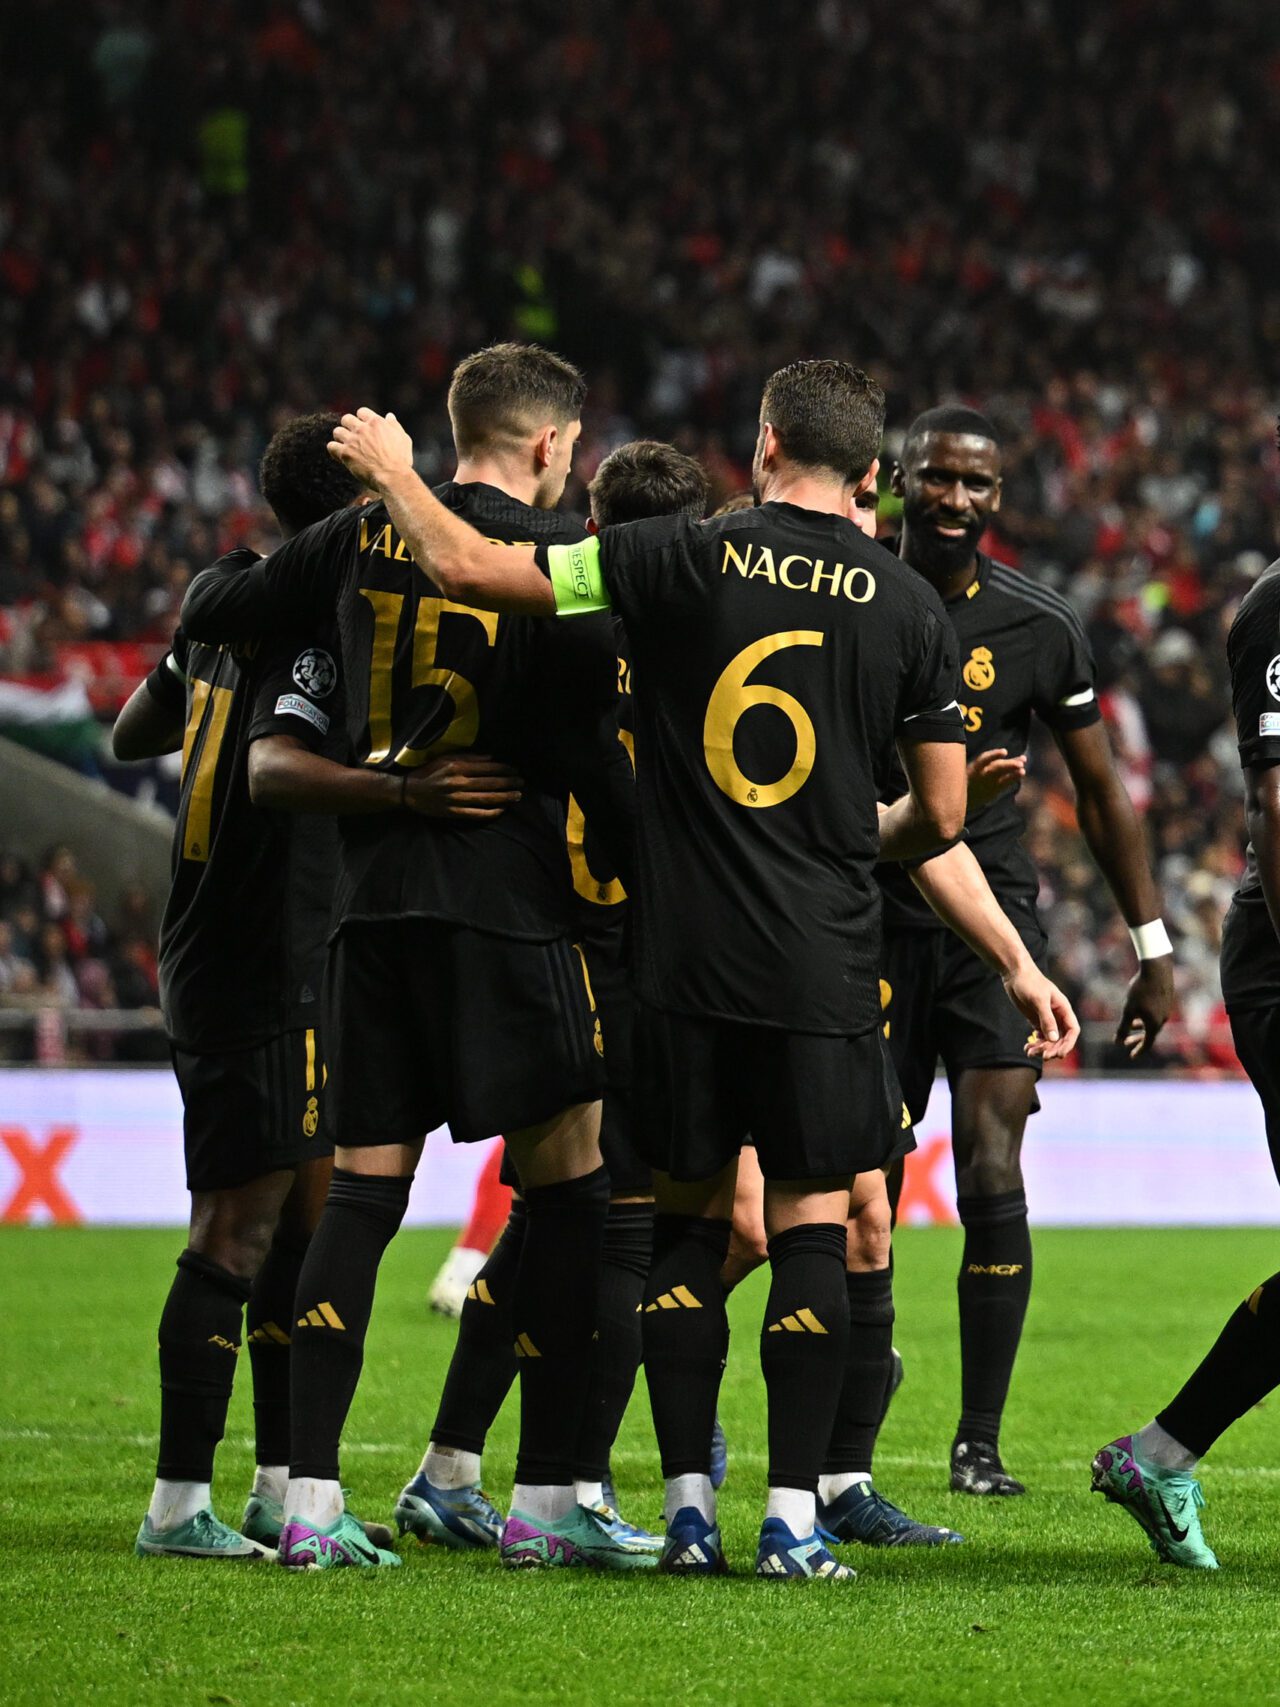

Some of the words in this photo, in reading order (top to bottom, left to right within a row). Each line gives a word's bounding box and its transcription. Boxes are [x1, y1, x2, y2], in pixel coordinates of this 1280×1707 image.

[572, 548, 589, 599] RESPECT
[722, 541, 876, 603] NACHO
[359, 588, 499, 767] 15
[703, 630, 825, 808] 6
